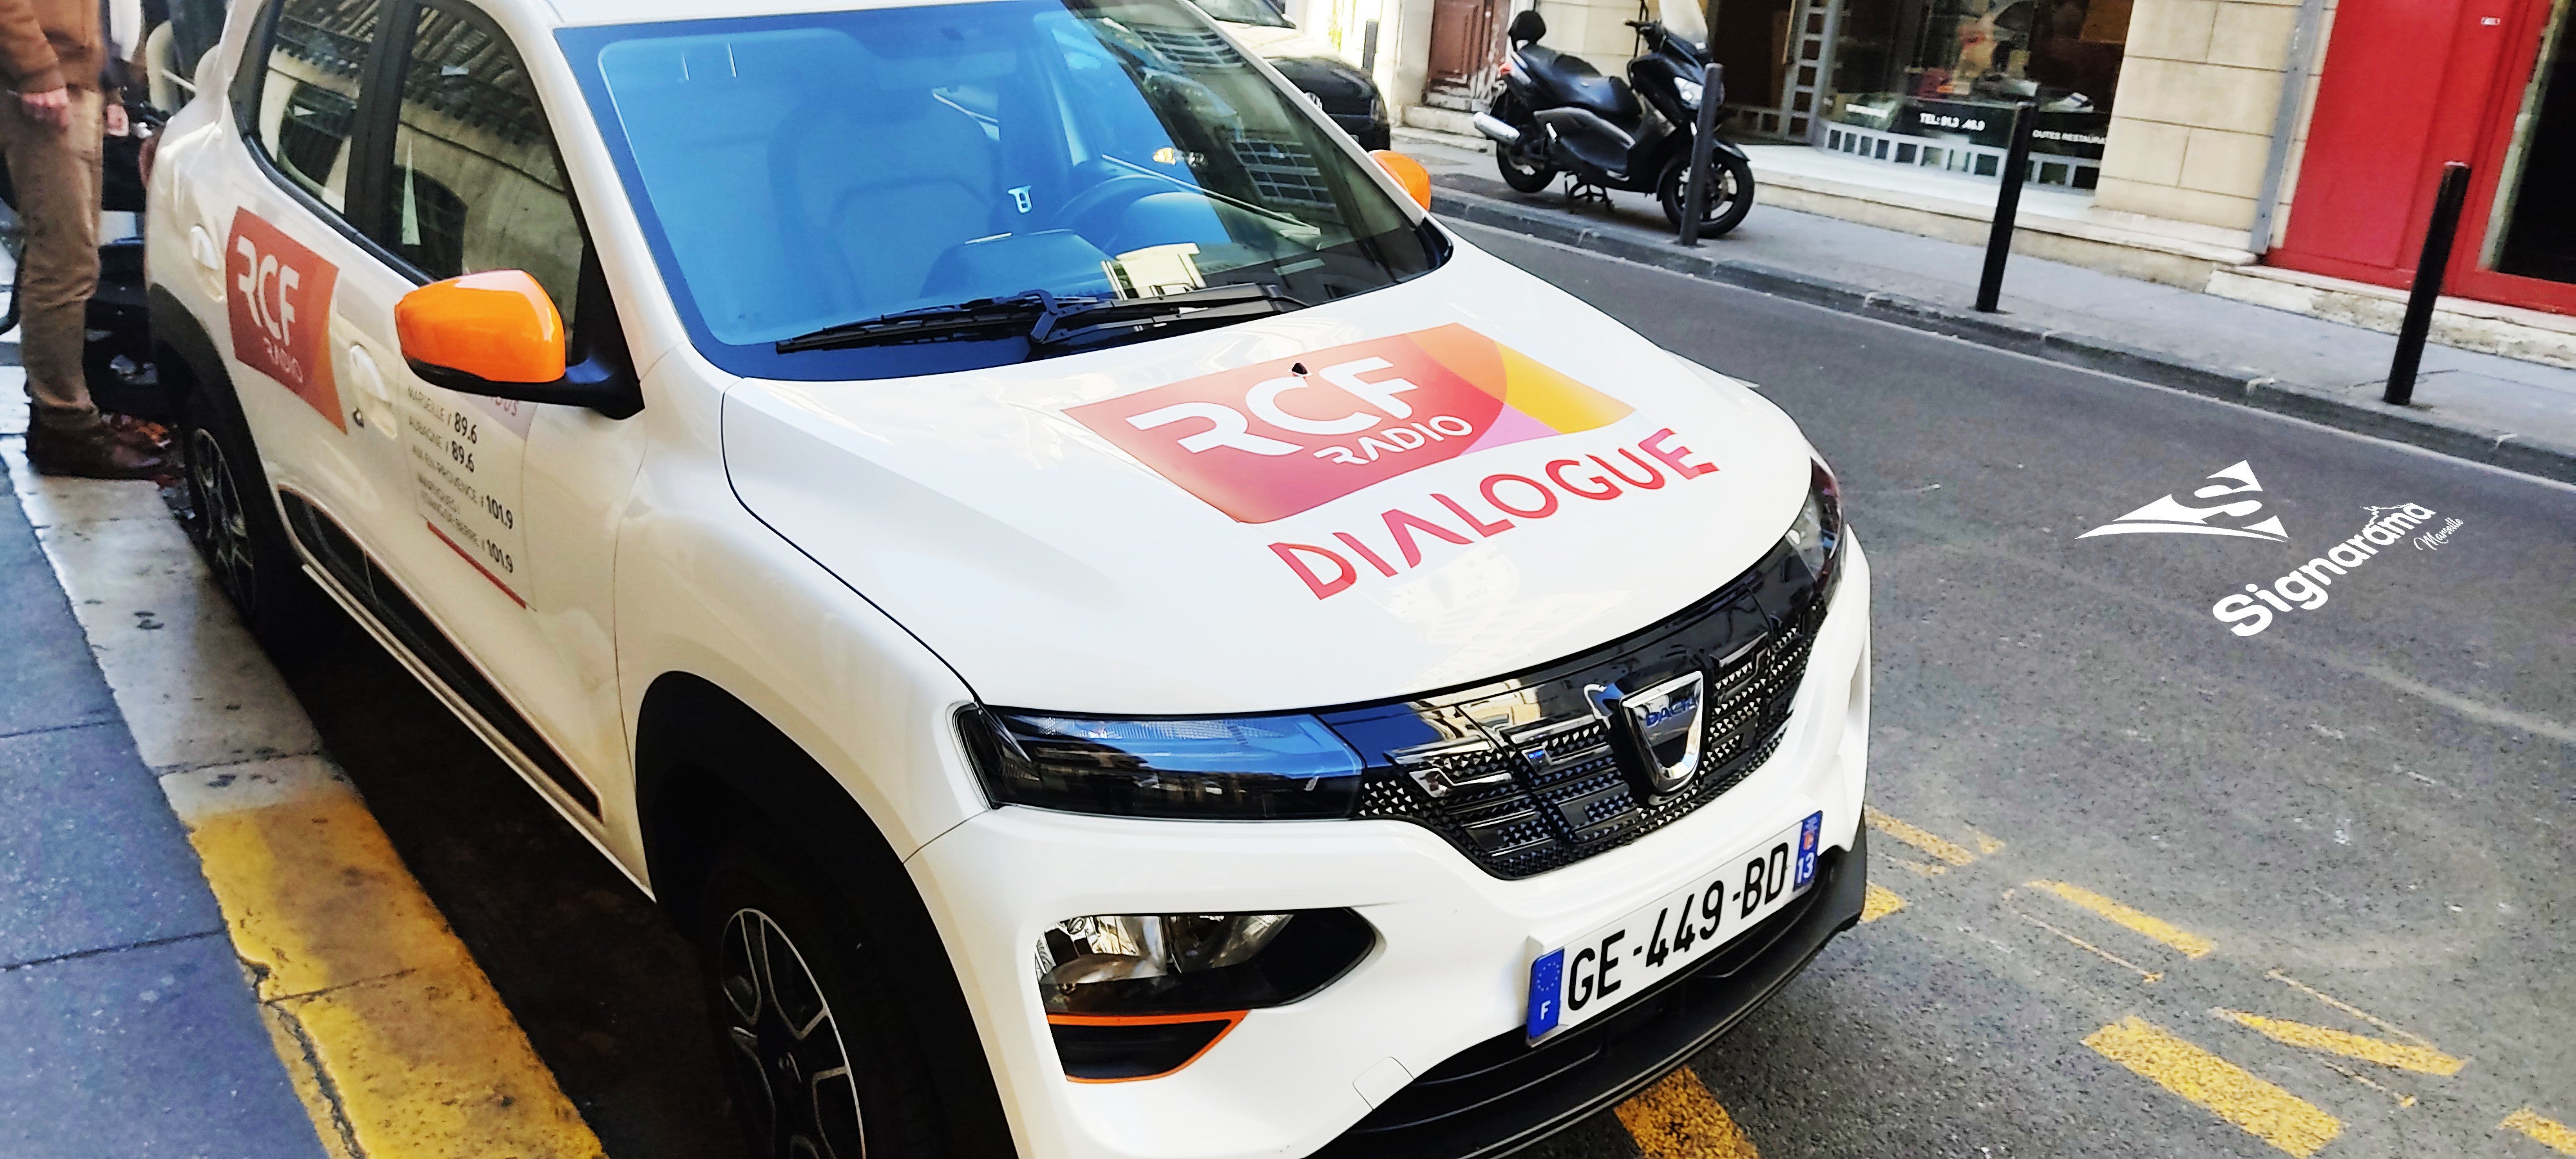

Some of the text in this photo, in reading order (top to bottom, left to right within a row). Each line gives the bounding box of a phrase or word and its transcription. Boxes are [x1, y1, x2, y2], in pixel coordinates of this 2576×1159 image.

[2032, 129, 2107, 144] OUTES RESTAURA
[237, 235, 299, 346] RCF
[263, 337, 303, 383] RADIO
[454, 412, 477, 444] 89.6
[1125, 355, 1418, 457] RCF
[451, 440, 475, 473] 89.6
[1312, 414, 1474, 466] RADIO
[486, 495, 513, 529] 101.9
[1267, 428, 1719, 600] DIALOGUE
[487, 538, 513, 573] 101.9
[1540, 999, 1551, 1021] F
[1797, 852, 1815, 883] 13
